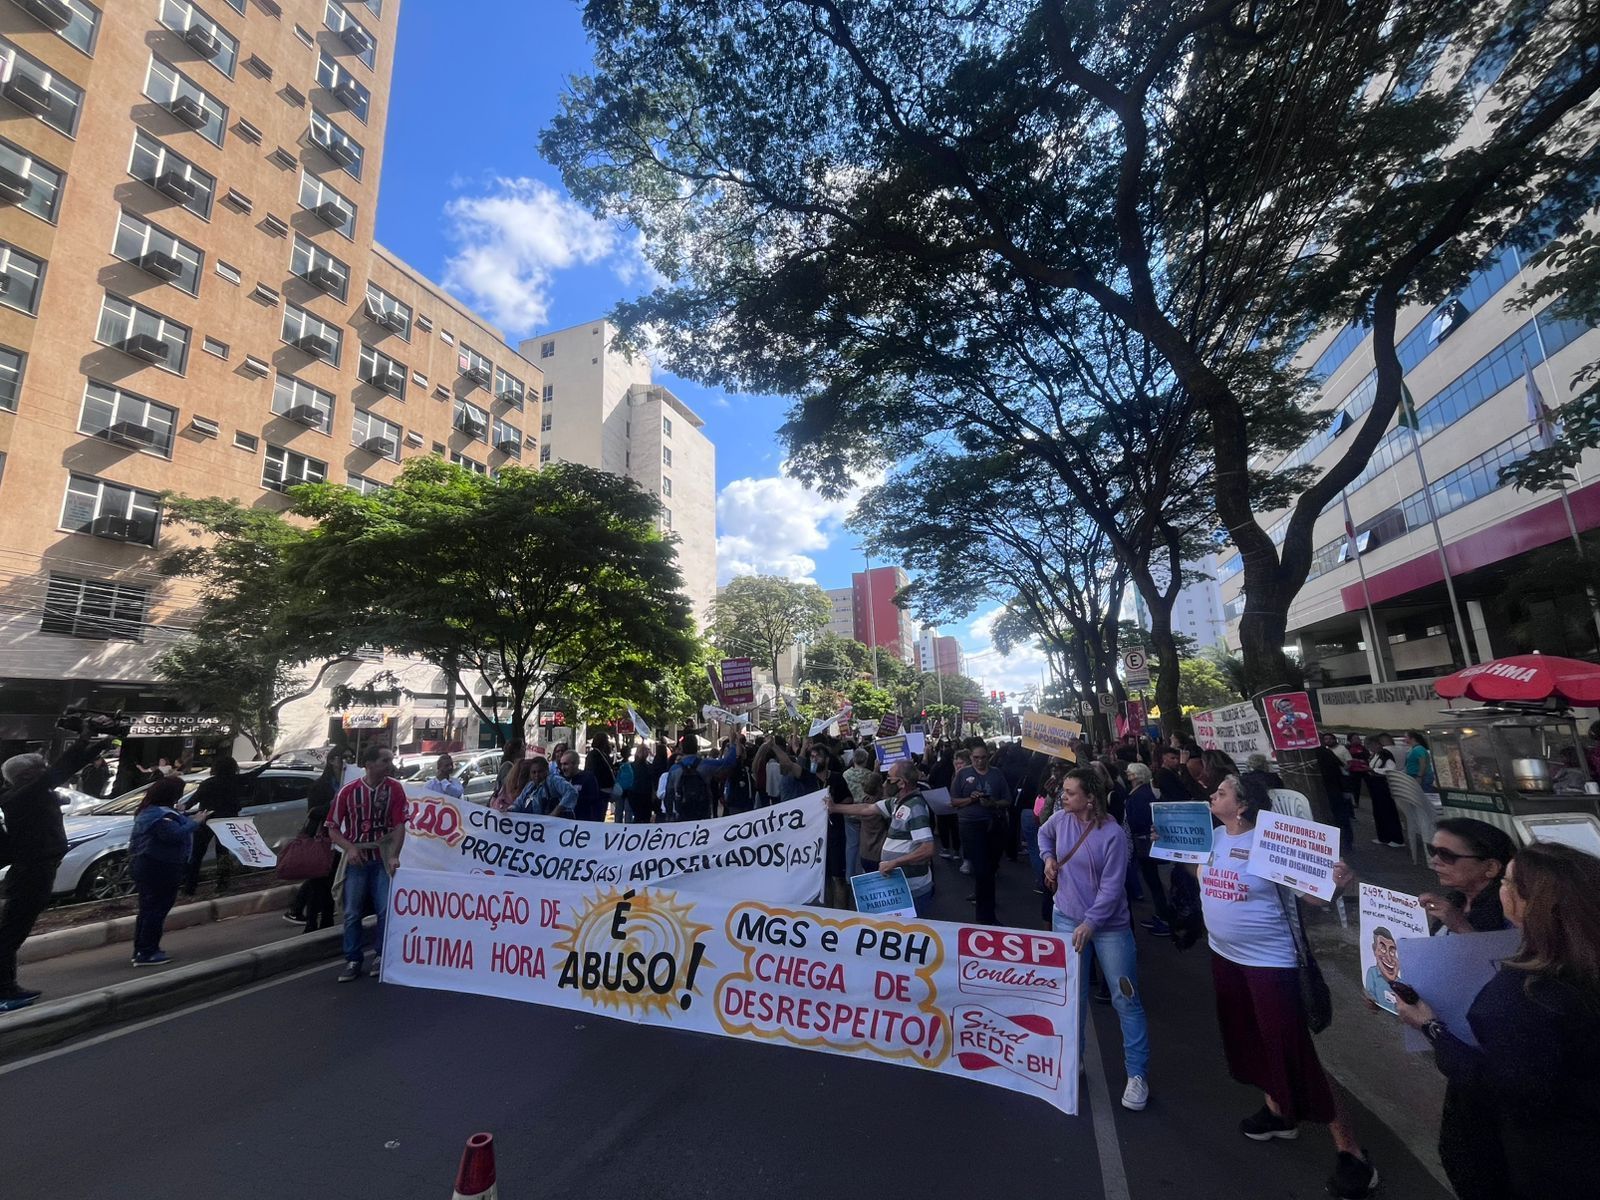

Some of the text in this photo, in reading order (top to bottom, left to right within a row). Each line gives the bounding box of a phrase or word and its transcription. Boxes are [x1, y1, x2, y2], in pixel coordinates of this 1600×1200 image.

[1130, 655, 1138, 667] E
[145, 714, 194, 724] CENTRO
[469, 810, 546, 844] chega
[559, 824, 591, 848] de
[604, 824, 710, 851] violência
[724, 808, 806, 842] contra
[1263, 829, 1307, 849] MUNICIPAIS
[1274, 821, 1326, 842] SERVIDORES/AS
[1259, 840, 1297, 857] MERECEM
[1268, 854, 1288, 867] COM
[1288, 859, 1327, 879] DIGNIDADE!
[394, 888, 561, 931] CONVOCAÇÃO DE
[610, 889, 636, 940] É
[402, 926, 546, 980] ÚLTIMA HORA
[736, 912, 931, 965] MGS e PBH
[967, 931, 1055, 963] CSP
[755, 953, 912, 1002] CHEGA DE
[962, 960, 1061, 990] Conlutas
[724, 986, 941, 1059] DESRESPEITO!
[962, 1011, 1030, 1045] Sind
